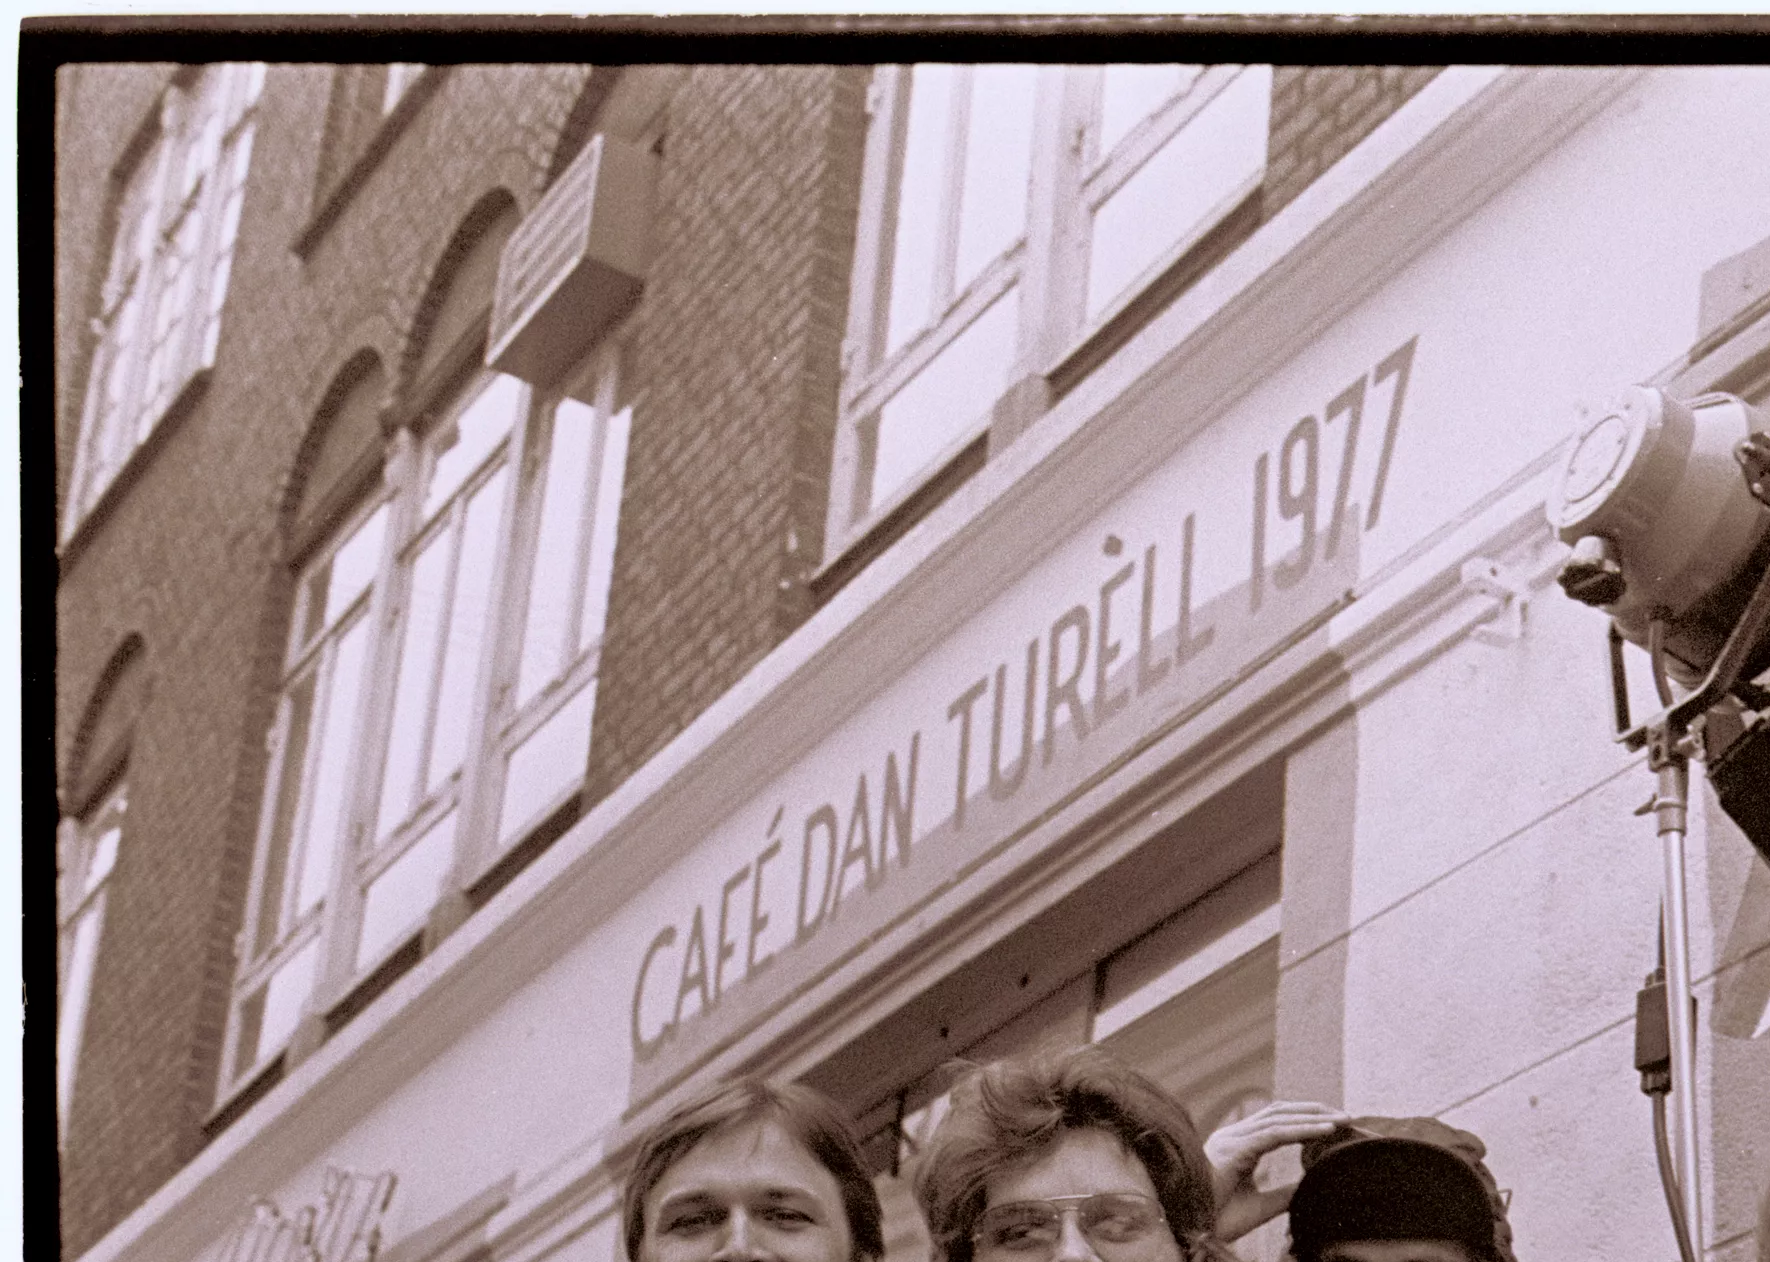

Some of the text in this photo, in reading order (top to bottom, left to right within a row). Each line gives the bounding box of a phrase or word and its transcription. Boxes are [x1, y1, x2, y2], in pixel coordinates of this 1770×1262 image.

[632, 804, 784, 1063] CAFÉ
[796, 730, 921, 947] DAN
[1251, 333, 1420, 613] 1977
